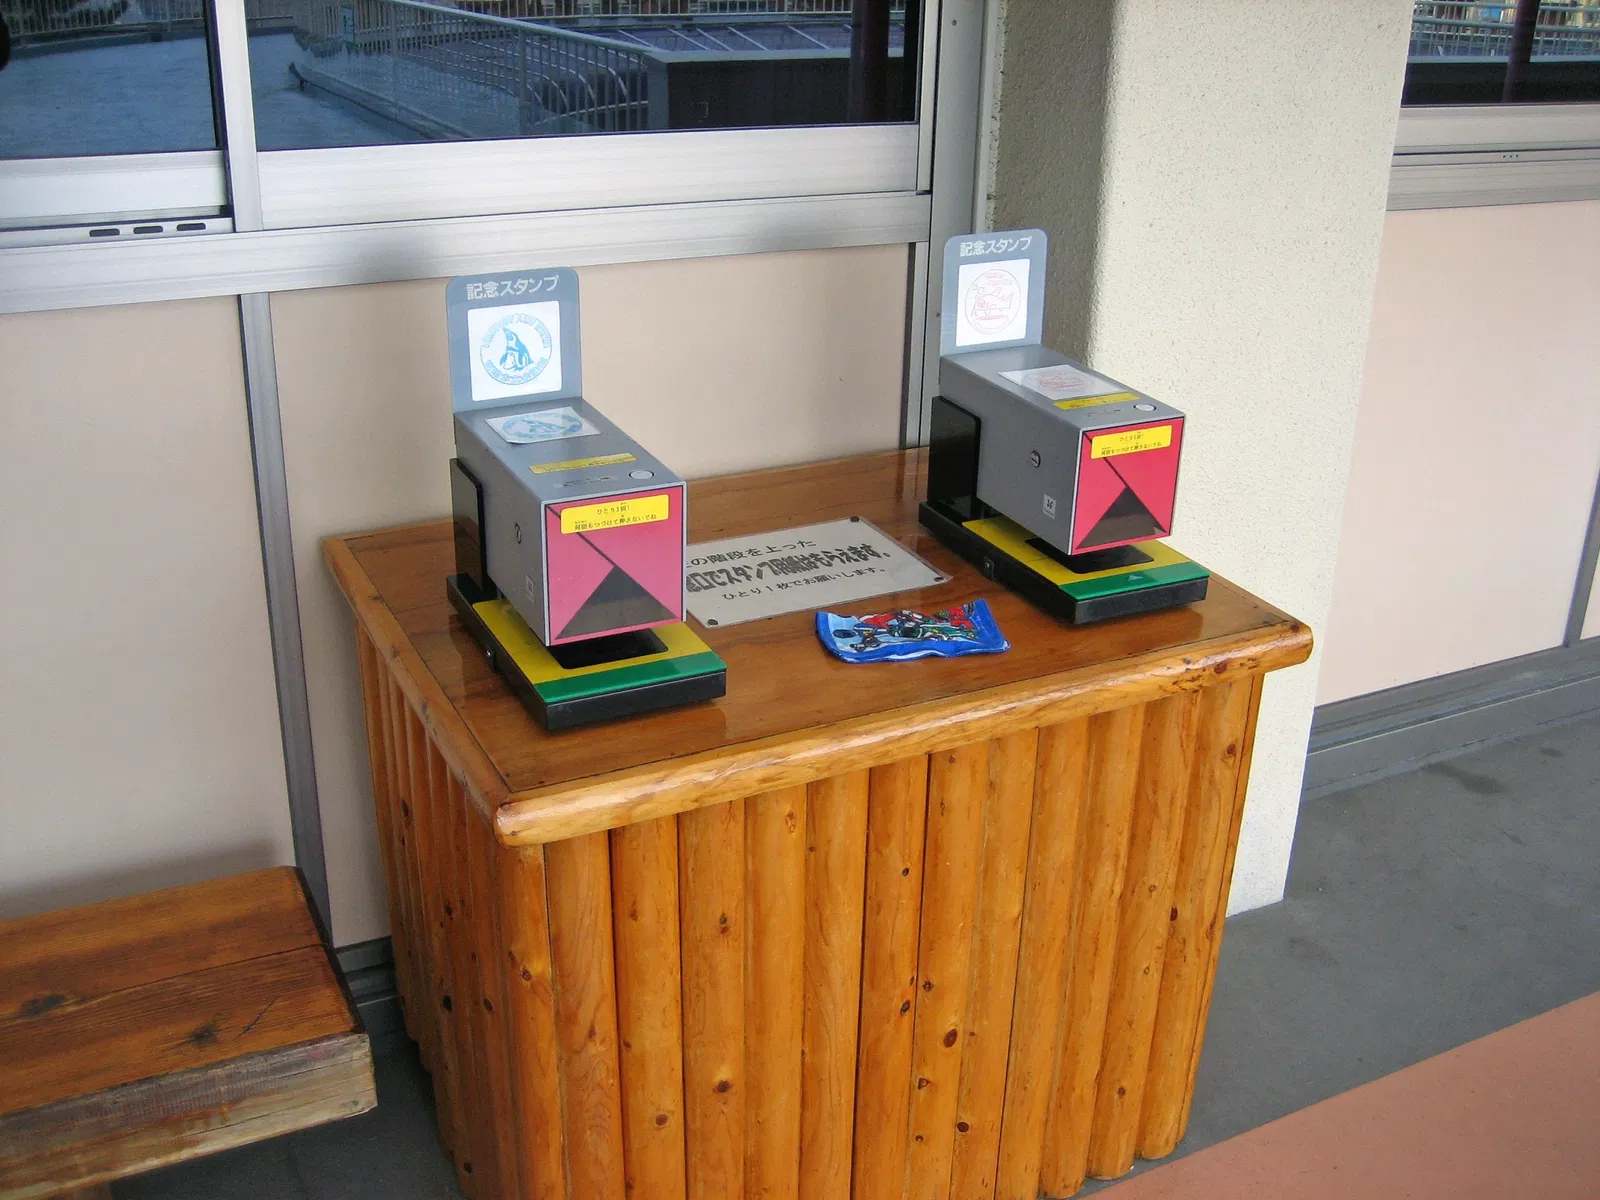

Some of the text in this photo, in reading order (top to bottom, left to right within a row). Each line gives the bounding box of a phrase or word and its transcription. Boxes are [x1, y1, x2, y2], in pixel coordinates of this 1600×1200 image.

[959, 236, 1032, 257] 記念スタンプ
[466, 275, 559, 300] 記念スタンプ
[686, 540, 817, 568] の階段を上った
